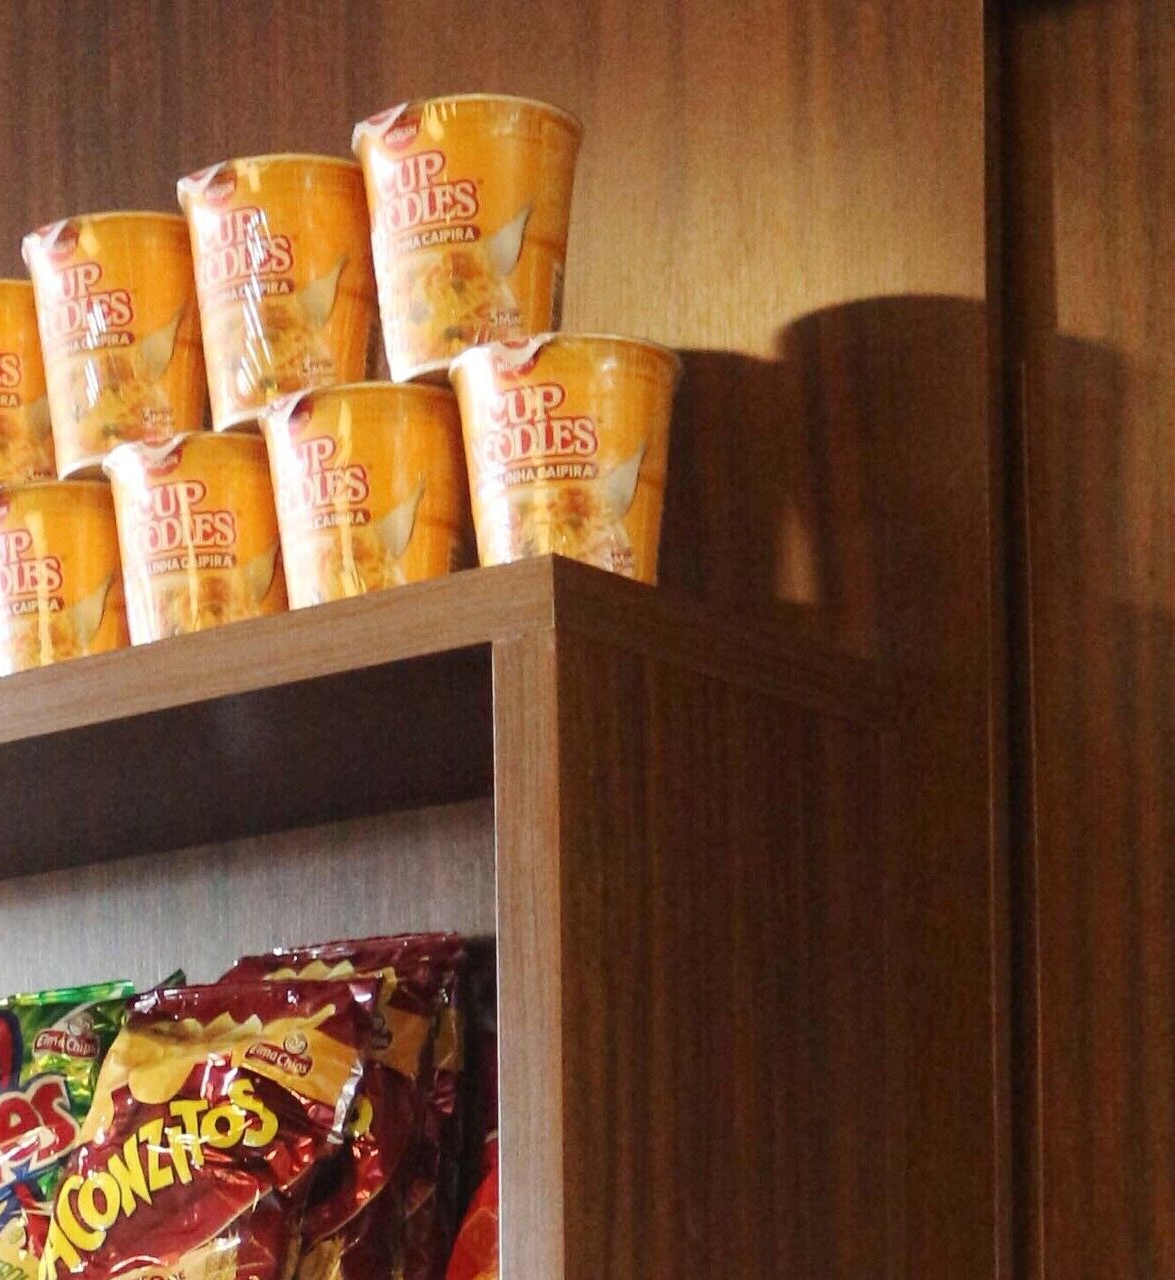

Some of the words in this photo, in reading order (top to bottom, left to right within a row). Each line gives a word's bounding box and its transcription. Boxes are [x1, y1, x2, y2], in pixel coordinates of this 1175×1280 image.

[216, 206, 260, 245] UP
[383, 178, 479, 232] ODLES
[202, 234, 293, 279] ODLES
[60, 262, 103, 299] UP
[49, 289, 134, 332] ODLES
[478, 415, 599, 465] OODLES
[298, 464, 370, 509] DLES
[143, 511, 237, 553] ODLES
[0, 556, 64, 596] DLES
[181, 554, 233, 572] CIPIRA
[276, 1051, 312, 1076] Chips
